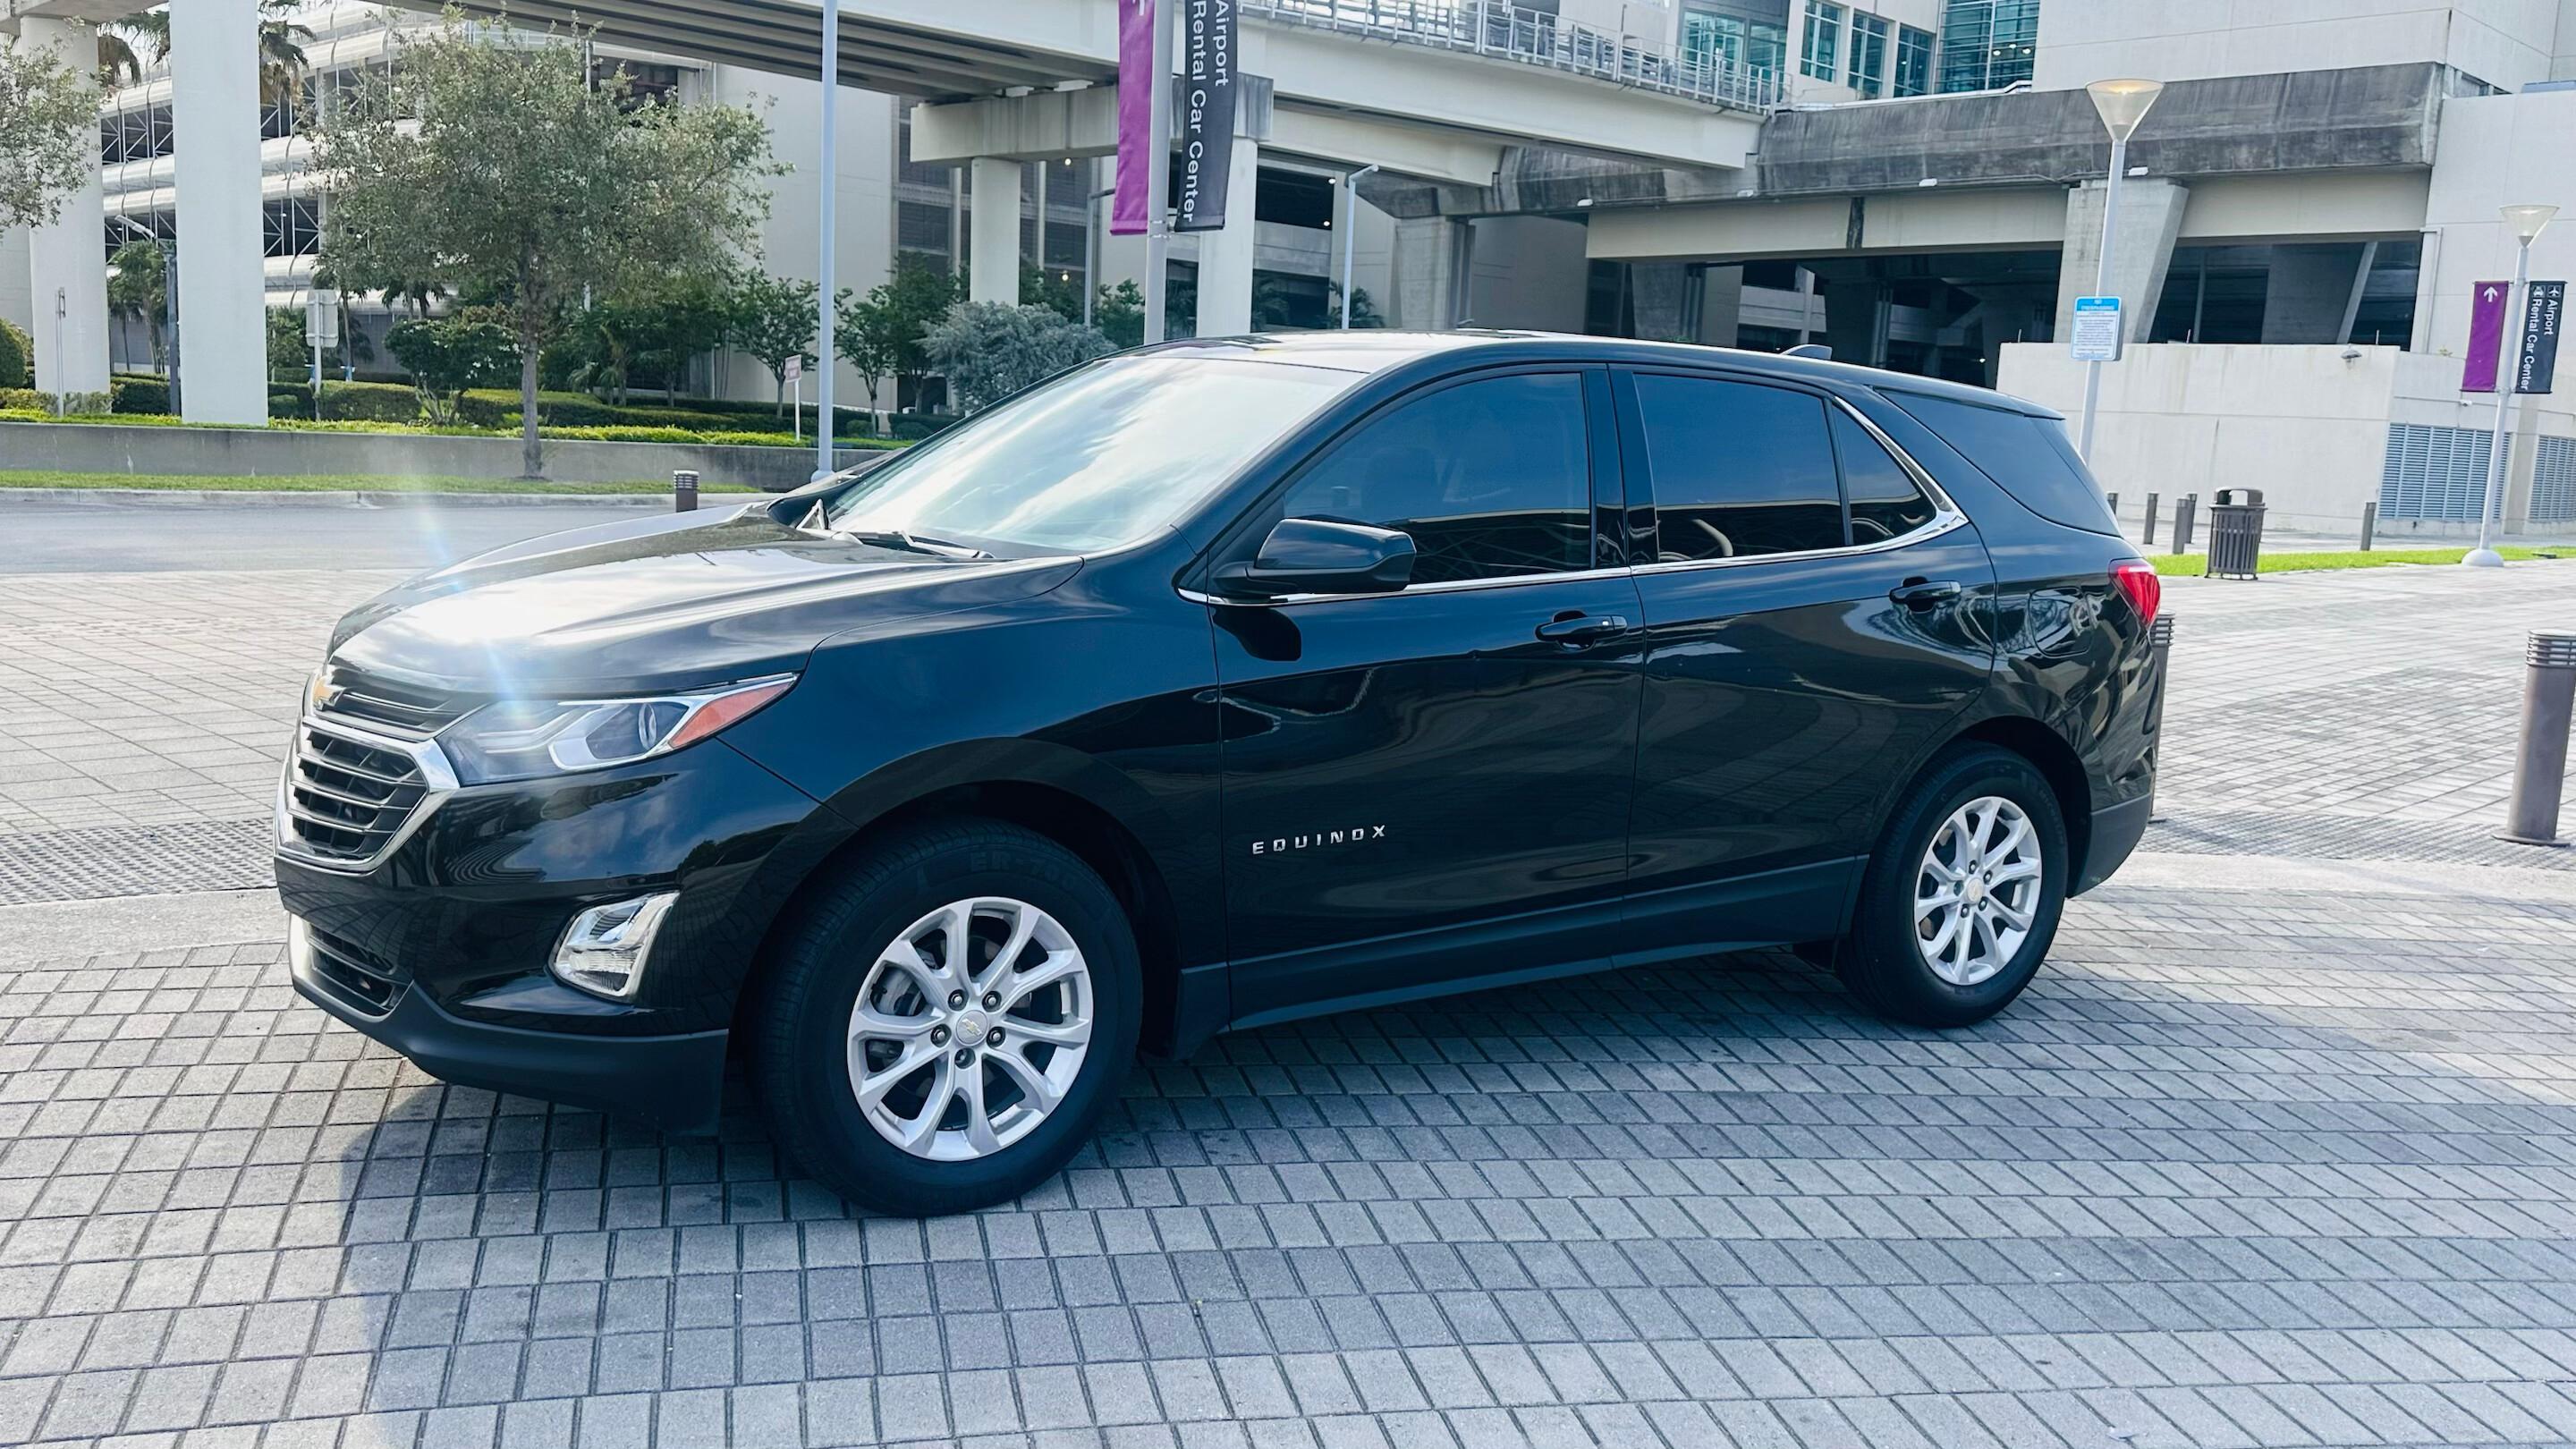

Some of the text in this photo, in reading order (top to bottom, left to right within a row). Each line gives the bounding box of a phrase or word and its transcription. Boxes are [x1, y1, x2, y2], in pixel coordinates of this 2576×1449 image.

[1213, 0, 1229, 86] Airport
[1183, 1, 1207, 223] Rental Car Center
[2521, 298, 2542, 390] Rental Car Center
[2544, 299, 2558, 335] Airport
[1252, 825, 1385, 854] EQUINOX
